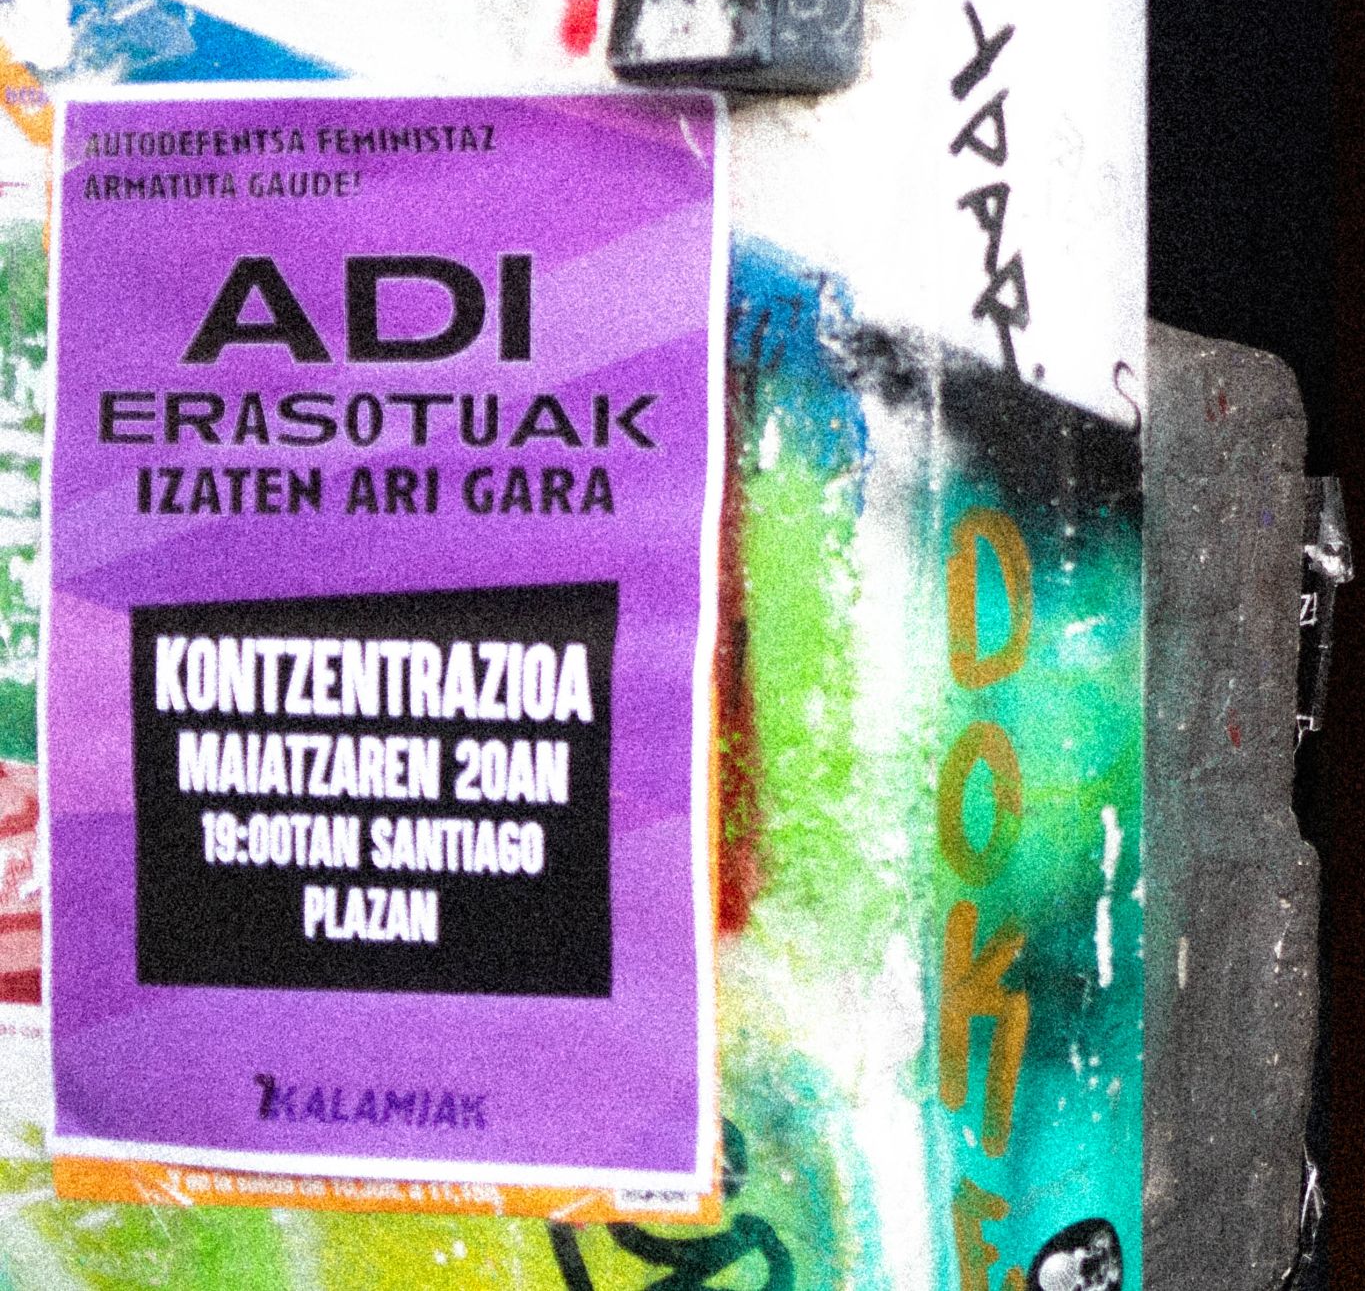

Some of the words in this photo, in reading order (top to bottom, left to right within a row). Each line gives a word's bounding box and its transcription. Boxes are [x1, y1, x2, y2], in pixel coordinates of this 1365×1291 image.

[86, 129, 305, 159] AUTODEFENTSA
[318, 124, 498, 155] FEMINISTAZ
[84, 170, 238, 202] ARMATUTA
[248, 169, 362, 200] GAUDE!
[181, 254, 533, 365] ADI
[100, 392, 661, 451] ERASOTUAK
[137, 468, 324, 516] IZATEN
[346, 468, 440, 515] ARI
[462, 468, 616, 516] GARA
[154, 635, 594, 723] KONTZENTRAZIOA
[178, 731, 441, 801] MAIATZAREN
[455, 738, 570, 804] 20AN
[200, 812, 360, 870] 19:00TAN
[371, 819, 546, 875] SANTIAGO
[303, 886, 440, 945] PLAZAN
[254, 1071, 490, 1132] 7KALAMIAK
